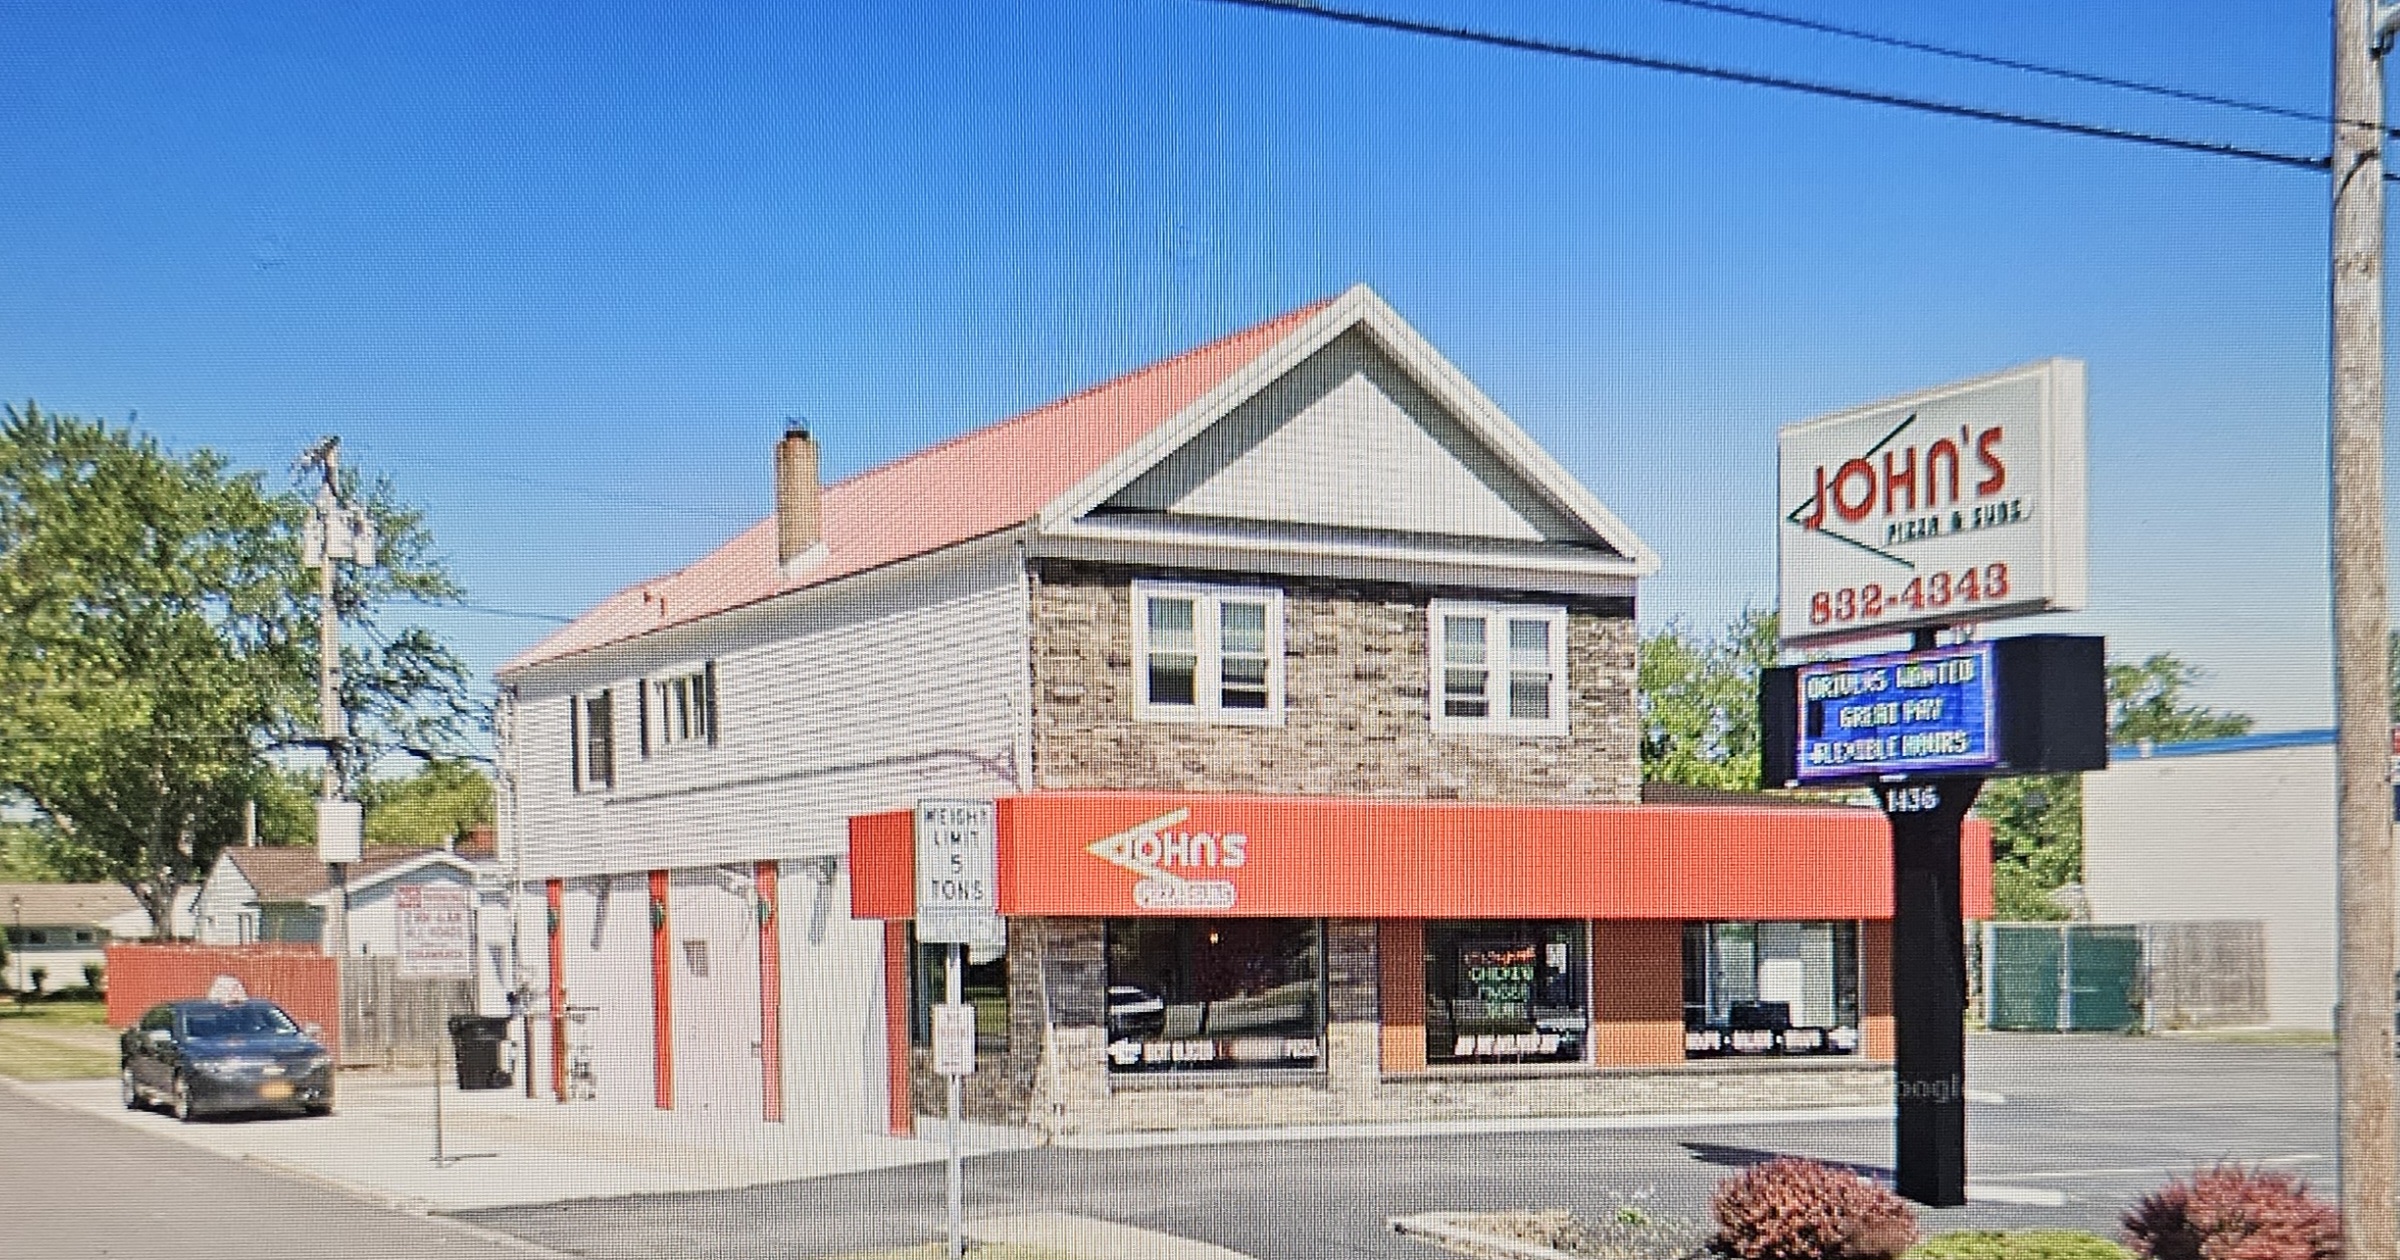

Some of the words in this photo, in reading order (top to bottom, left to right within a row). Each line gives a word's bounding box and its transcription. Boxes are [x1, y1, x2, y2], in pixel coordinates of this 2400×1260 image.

[1803, 424, 2006, 531] JOHN'S
[1886, 516, 1939, 545] PIZZA
[1972, 499, 2022, 529] SUBS
[1809, 561, 2010, 625] 832-4343
[1807, 669, 1889, 701] DRIVERS
[1896, 658, 1974, 689] WANTED
[1839, 700, 1899, 728] GREAT
[1903, 697, 1944, 722] PAY
[1811, 735, 1898, 765] FLEXIBLE
[1902, 730, 1968, 757] HOURS
[1887, 784, 1940, 812] 1436
[923, 807, 989, 825] WEIGHT
[934, 830, 980, 847] LIMIT
[1109, 831, 1248, 868] JOHN'S
[950, 854, 963, 875] 5
[931, 880, 984, 901] TONS
